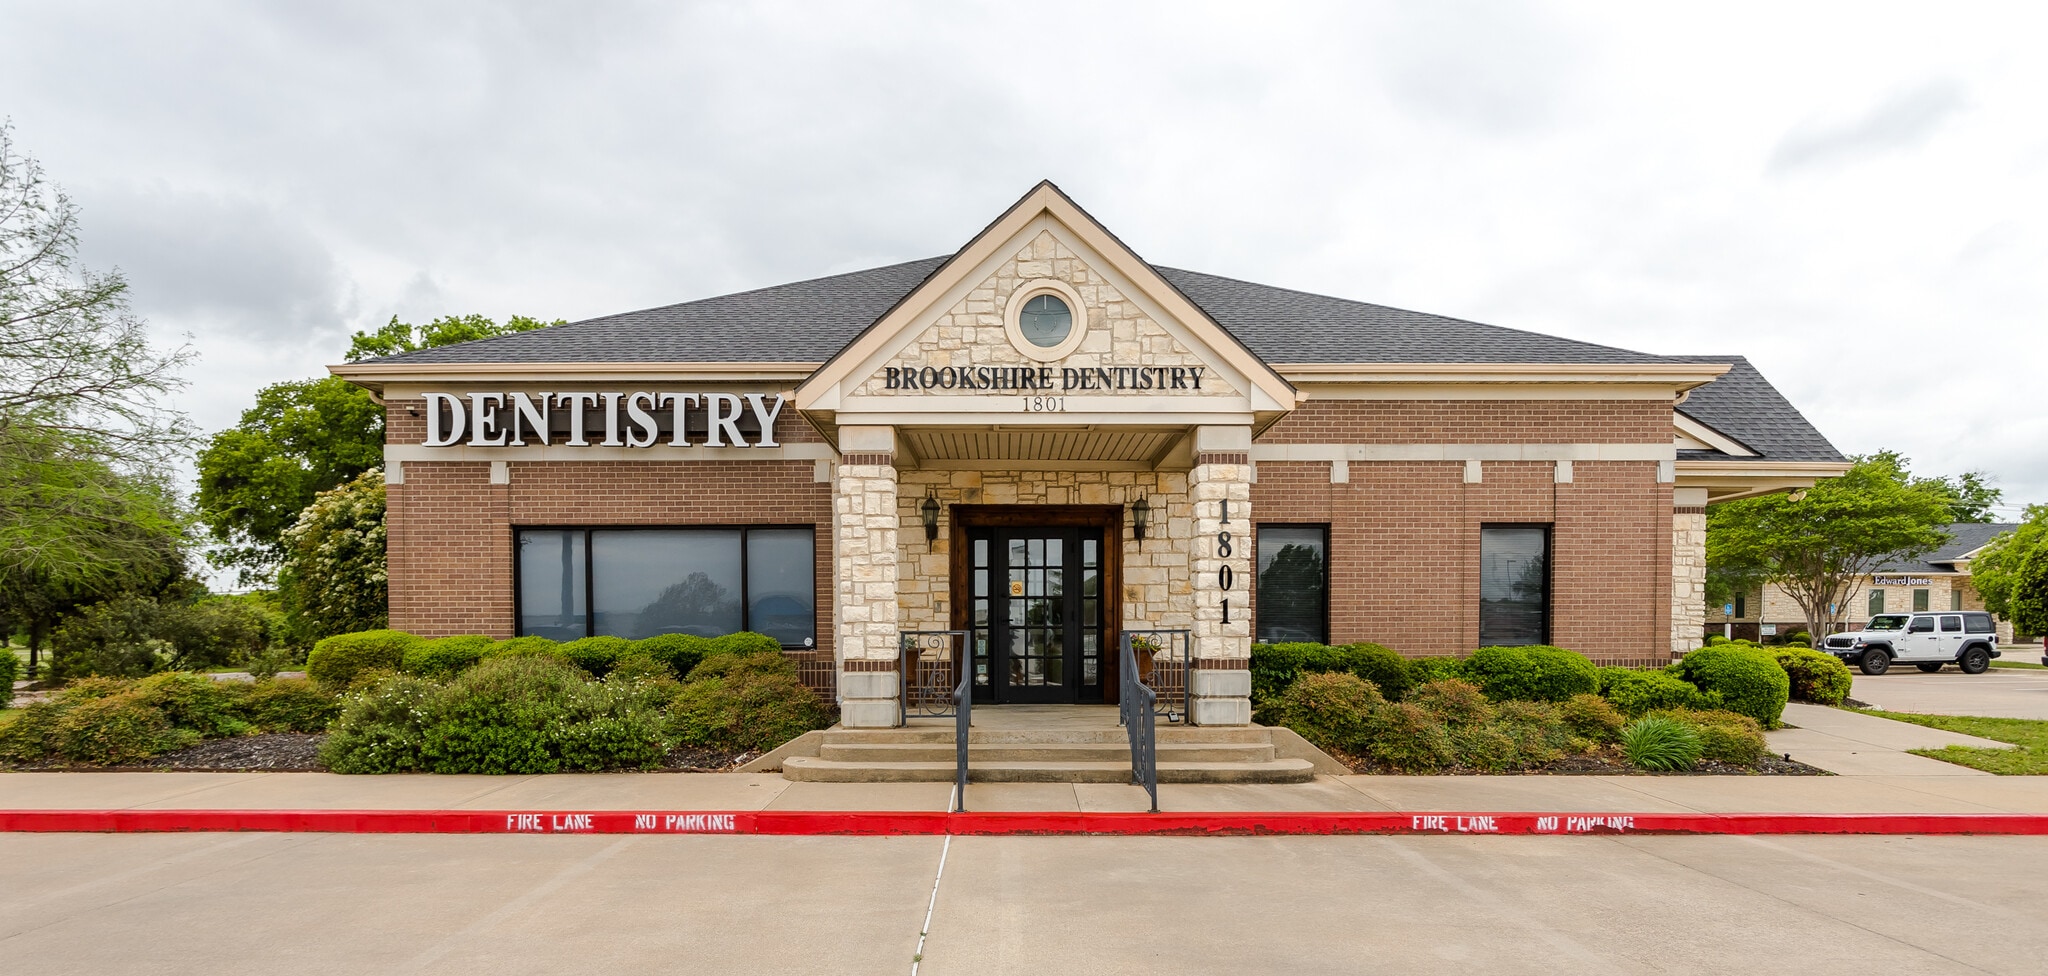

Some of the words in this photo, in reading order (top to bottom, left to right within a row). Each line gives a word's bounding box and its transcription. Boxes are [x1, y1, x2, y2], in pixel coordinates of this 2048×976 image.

[885, 366, 1053, 390] BROOKSHIRE
[1062, 366, 1205, 390] DENTISTRY
[1023, 396, 1066, 412] 1801
[421, 391, 785, 448] DENTISTRY
[1217, 498, 1233, 625] 1801
[506, 814, 543, 831] FIRE
[552, 814, 595, 831] LANE
[635, 814, 656, 830] NO
[666, 814, 736, 830] PARKING
[1412, 815, 1448, 832] FIRE
[1457, 815, 1498, 831] LANE
[1537, 816, 1558, 831] NO
[1567, 816, 1634, 831] PARKING
